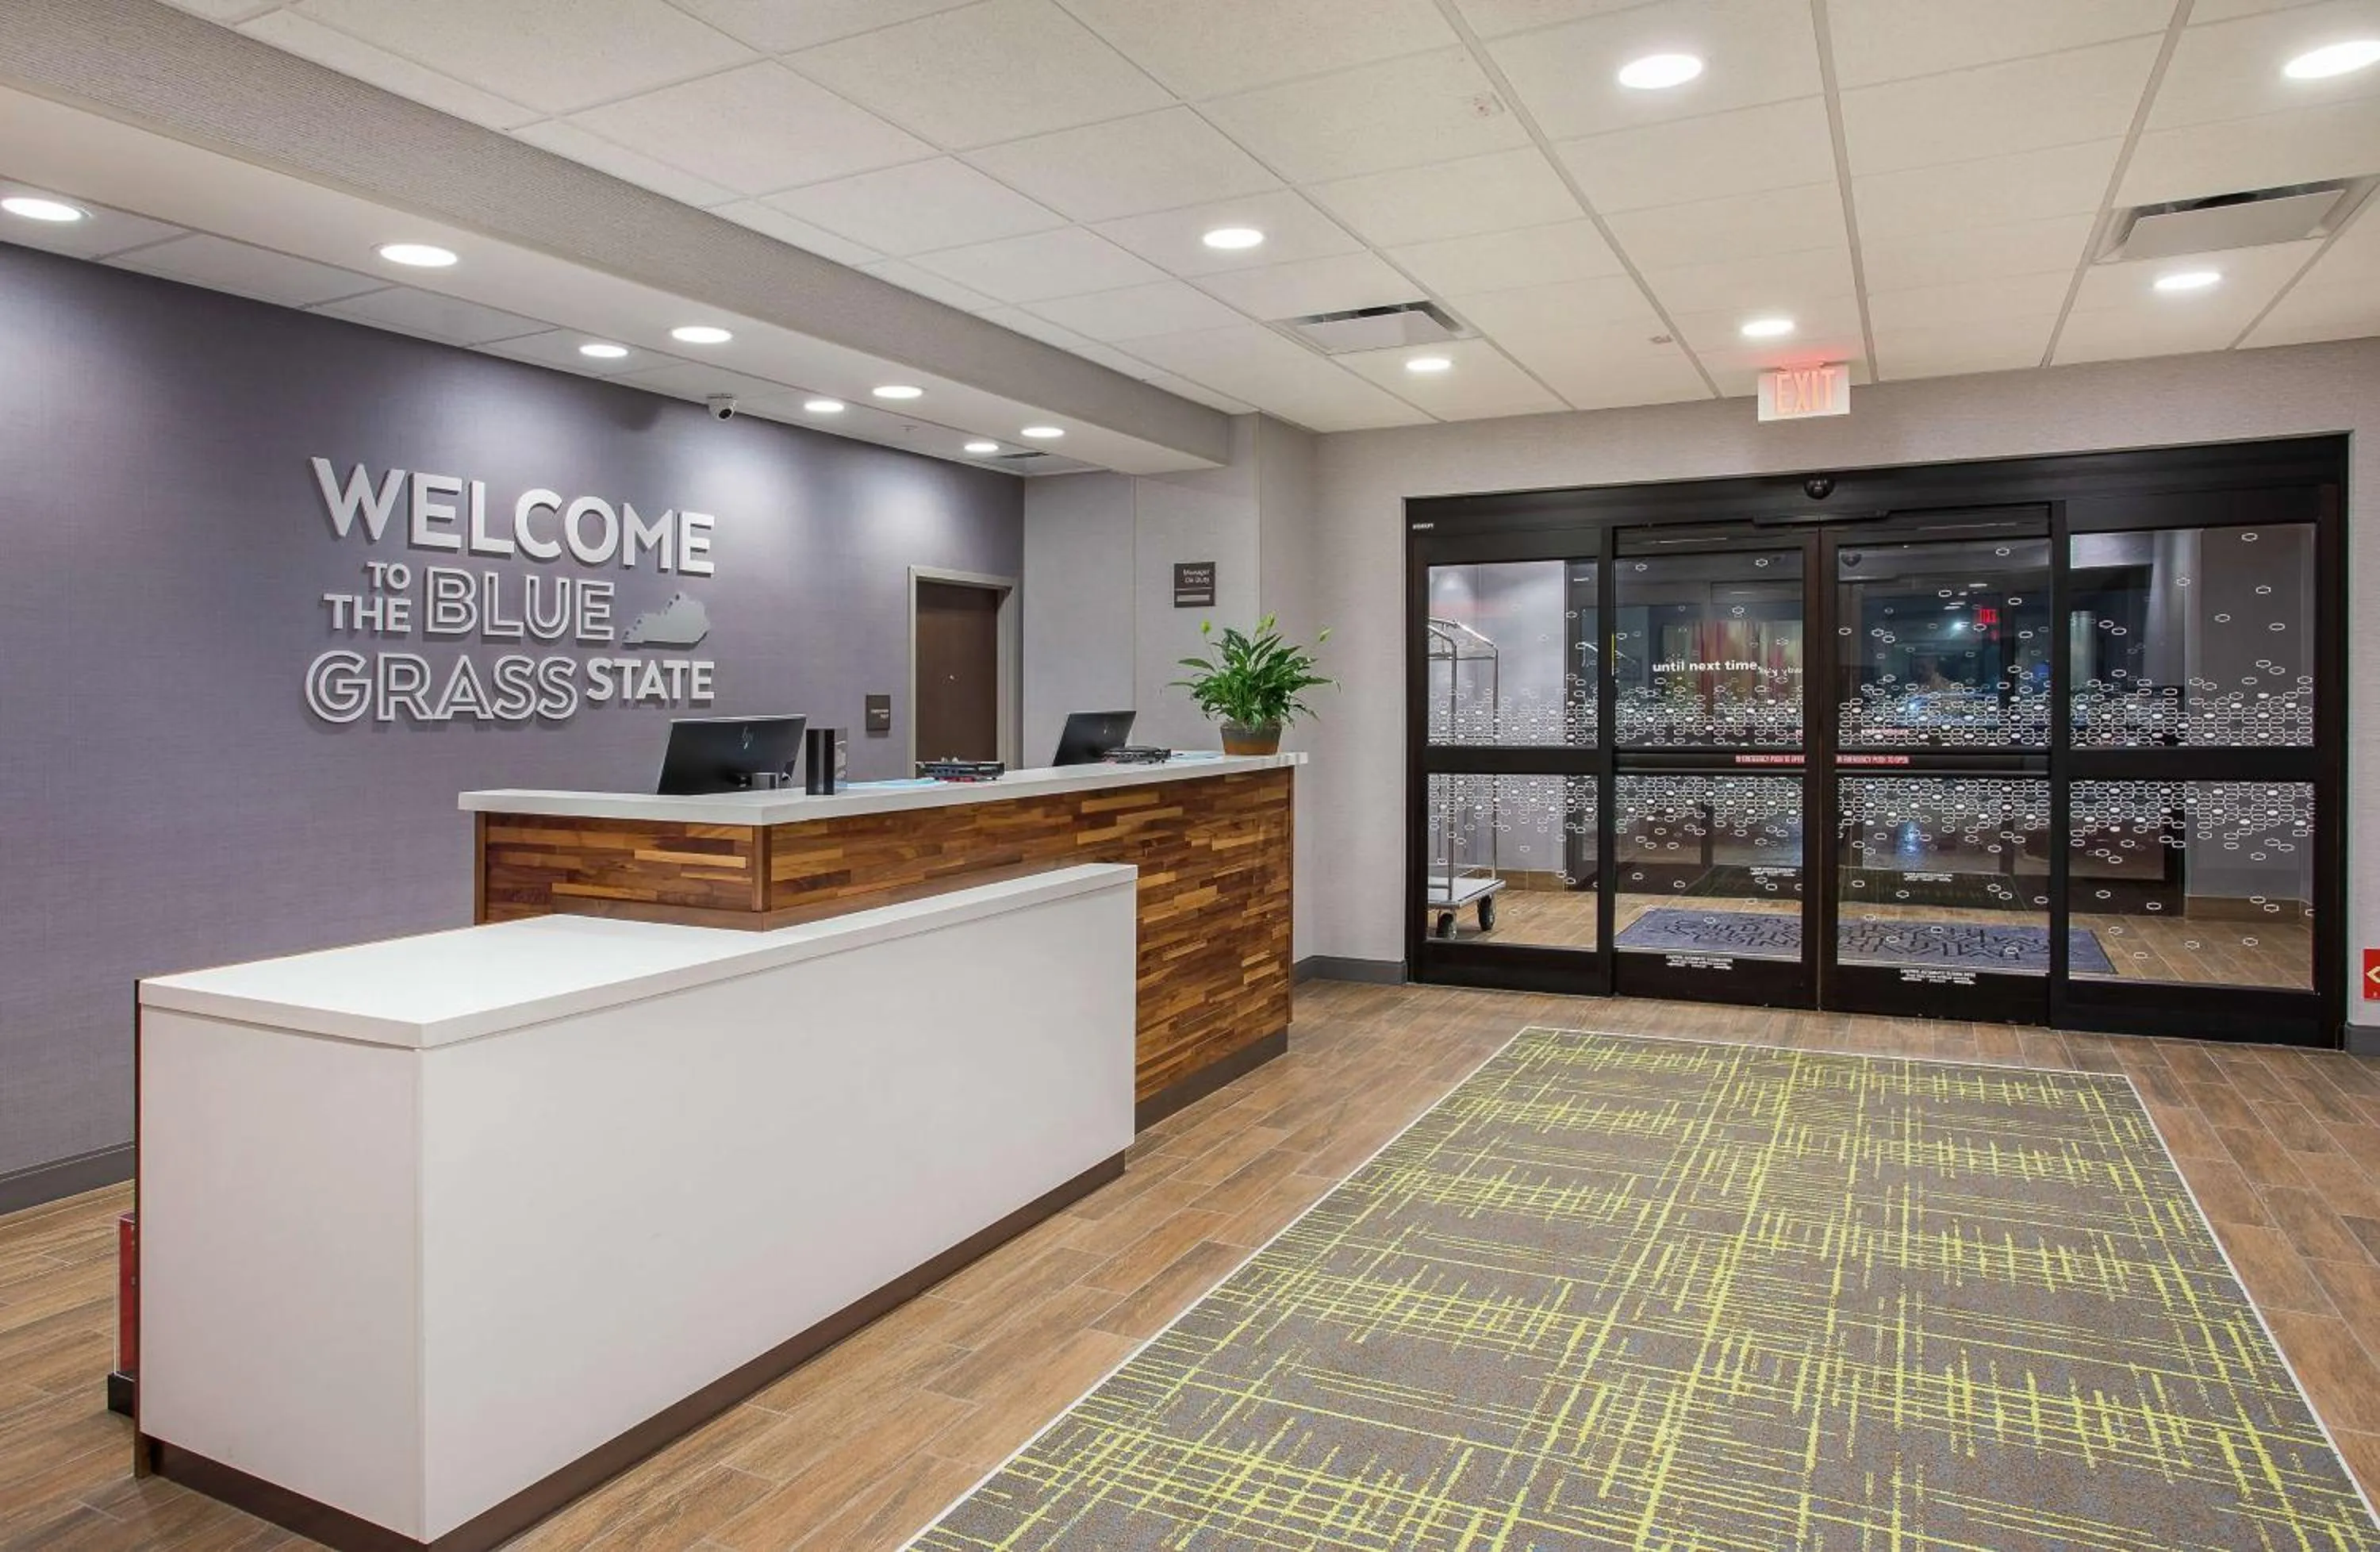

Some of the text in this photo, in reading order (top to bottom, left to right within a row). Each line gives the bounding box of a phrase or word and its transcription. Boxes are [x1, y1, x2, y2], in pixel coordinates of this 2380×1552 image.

[1775, 369, 1834, 414] EXIT
[310, 456, 715, 574] WELCOME
[323, 565, 615, 641] THE BLUE
[367, 561, 412, 590] TO
[305, 650, 716, 723] GRASS STATE
[1652, 660, 1684, 673] until
[1688, 662, 1721, 672] next
